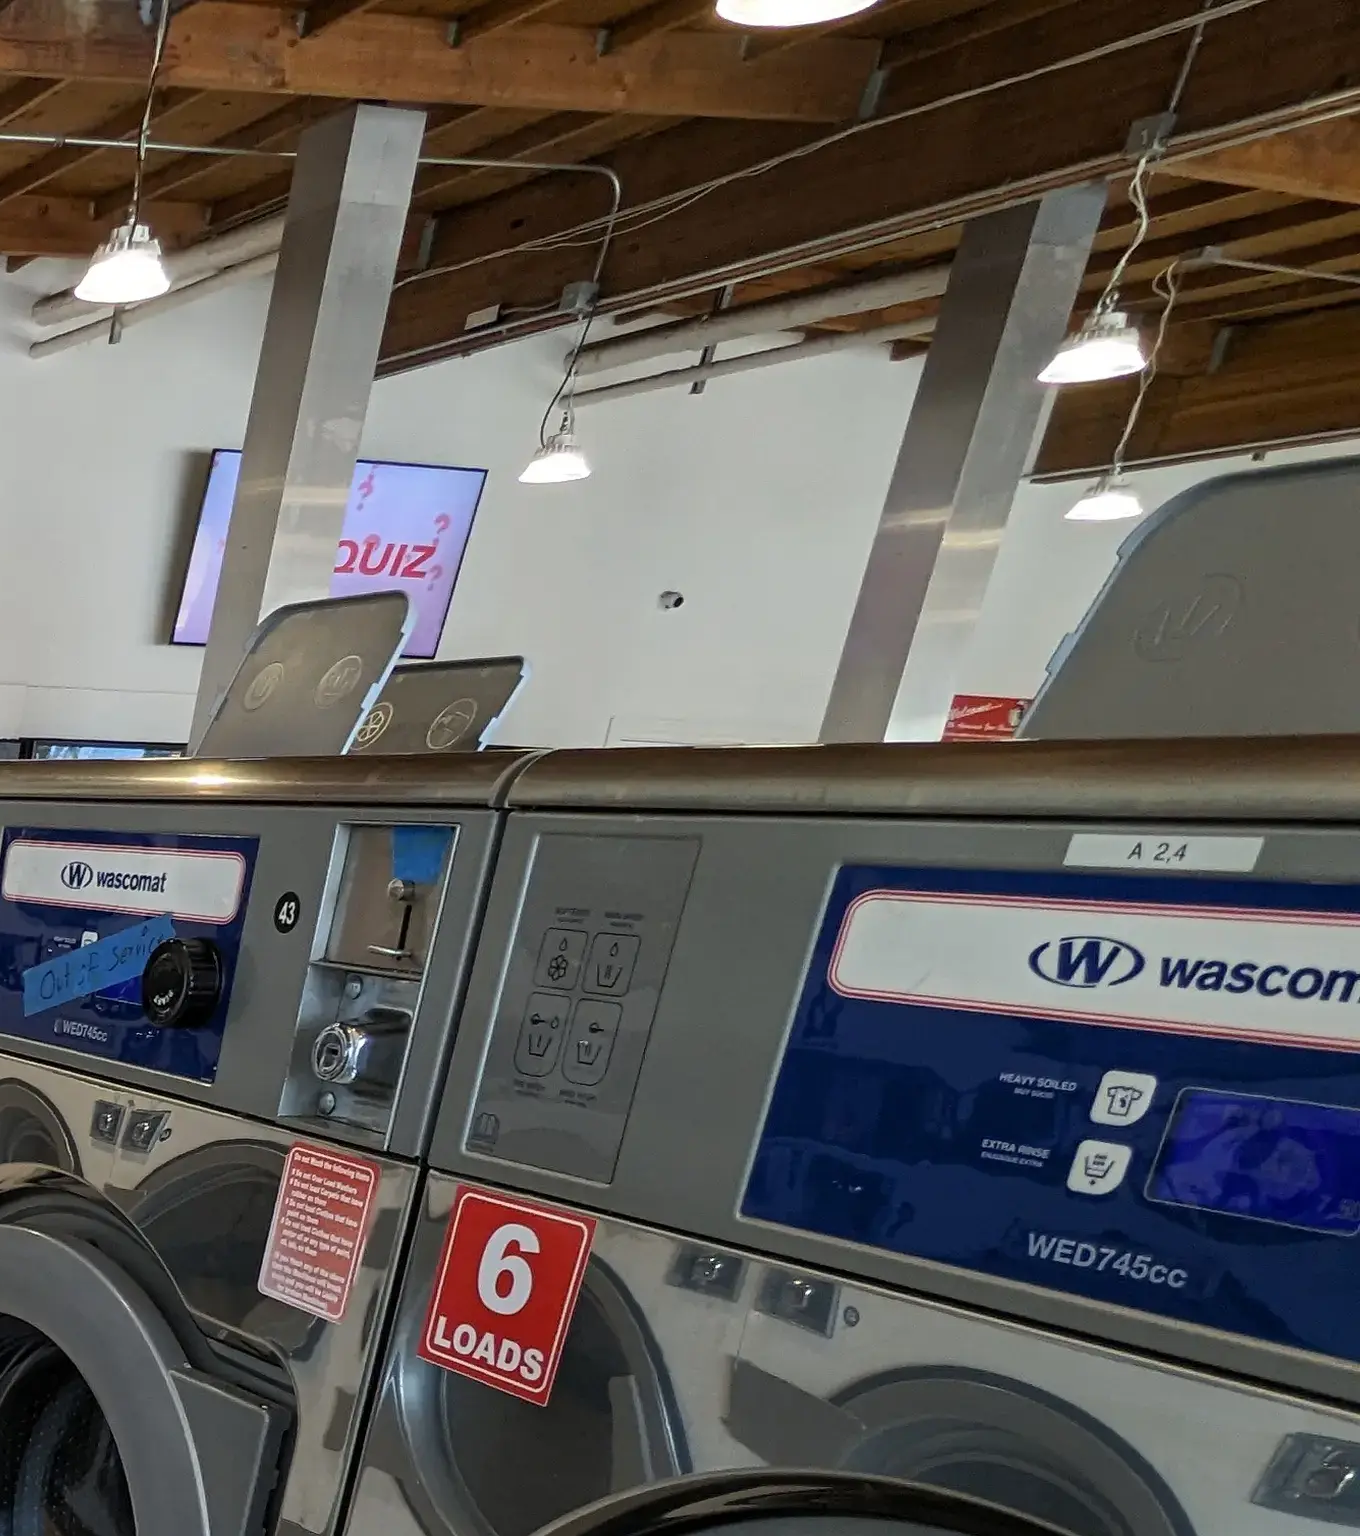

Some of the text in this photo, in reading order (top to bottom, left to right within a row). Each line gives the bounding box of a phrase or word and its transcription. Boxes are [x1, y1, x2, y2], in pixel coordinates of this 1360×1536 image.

[1128, 840, 1143, 860] A
[97, 870, 167, 893] wascomat
[278, 901, 296, 925] 43
[40, 959, 70, 999] Out
[62, 1019, 108, 1042] WED745cc
[999, 1072, 1078, 1091] HEAVY SOILED
[981, 1138, 1051, 1159] EXTRA RINSE
[477, 1224, 540, 1315] 6
[1027, 1232, 1188, 1289] WED745cc
[434, 1315, 545, 1382] LOADS
